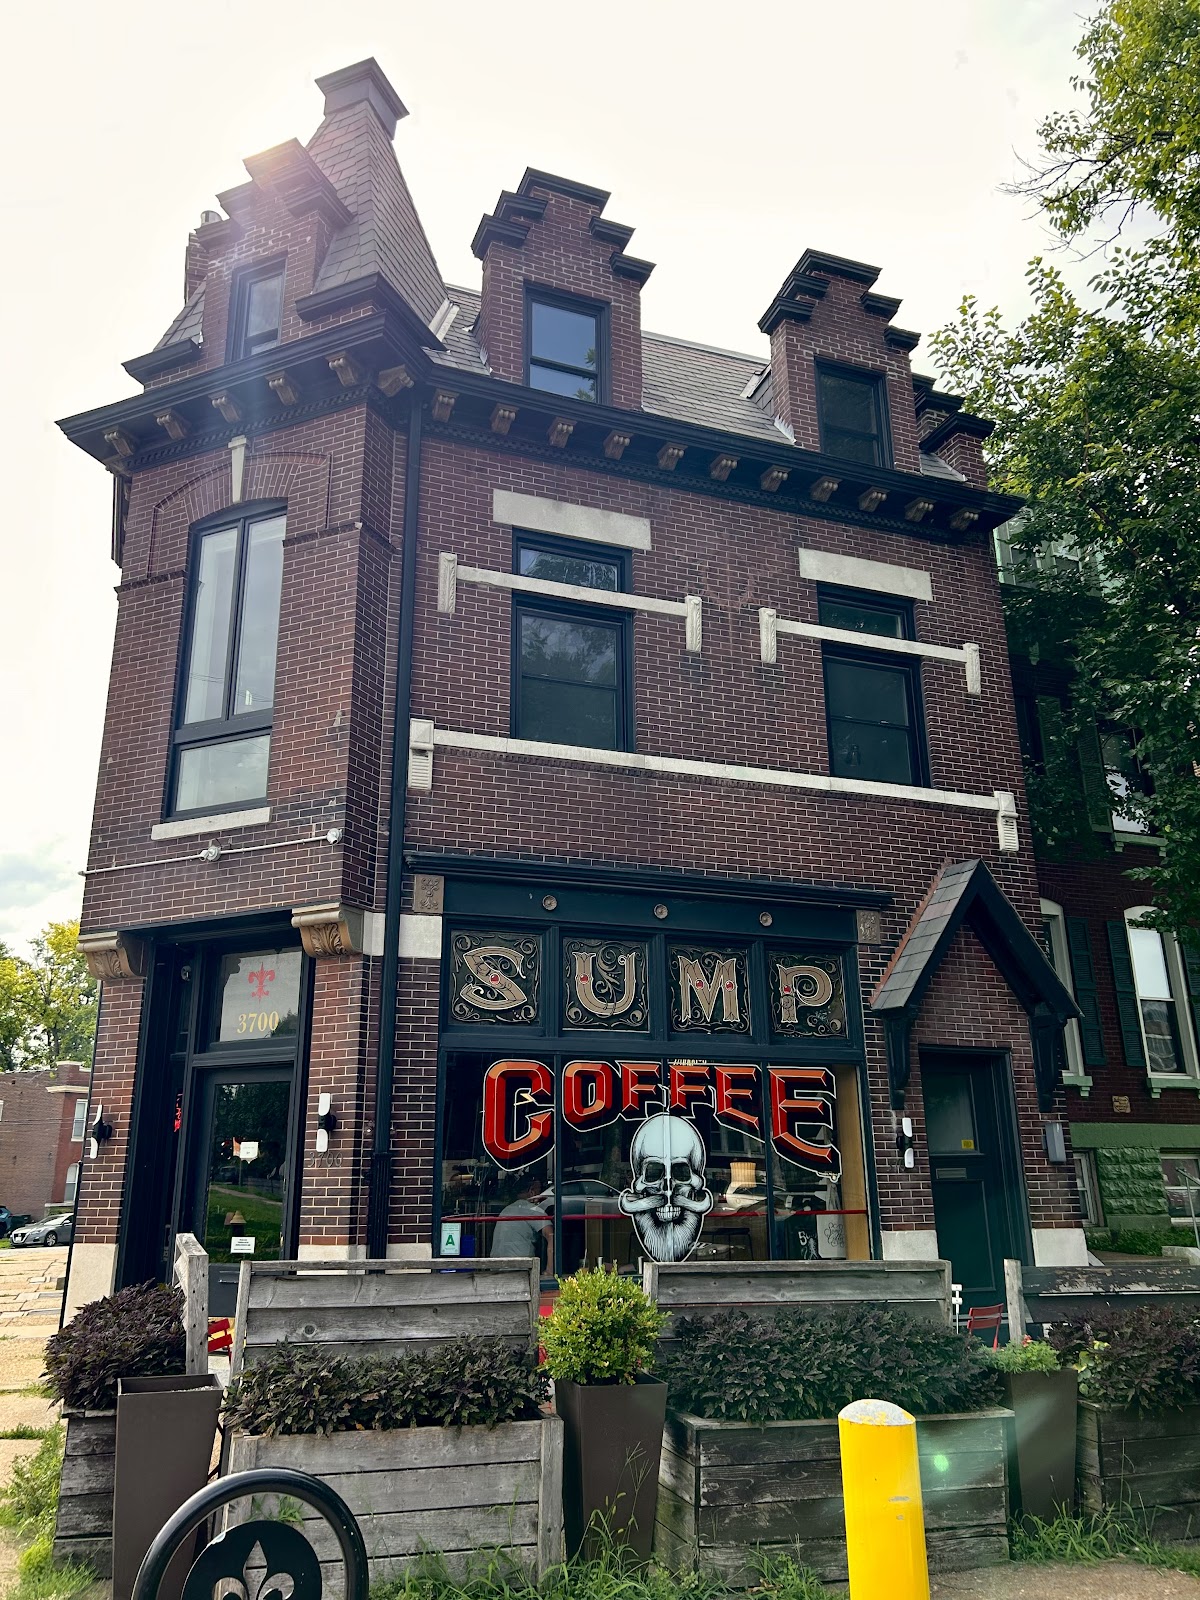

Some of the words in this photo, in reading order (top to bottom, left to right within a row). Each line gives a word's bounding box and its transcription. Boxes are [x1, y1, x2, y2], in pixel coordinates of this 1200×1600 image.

[460, 946, 833, 1024] SUMP
[237, 1011, 279, 1034] 3700
[482, 1059, 842, 1174] COFFEE
[307, 1152, 344, 1168] 3700
[445, 1234, 455, 1246] A
